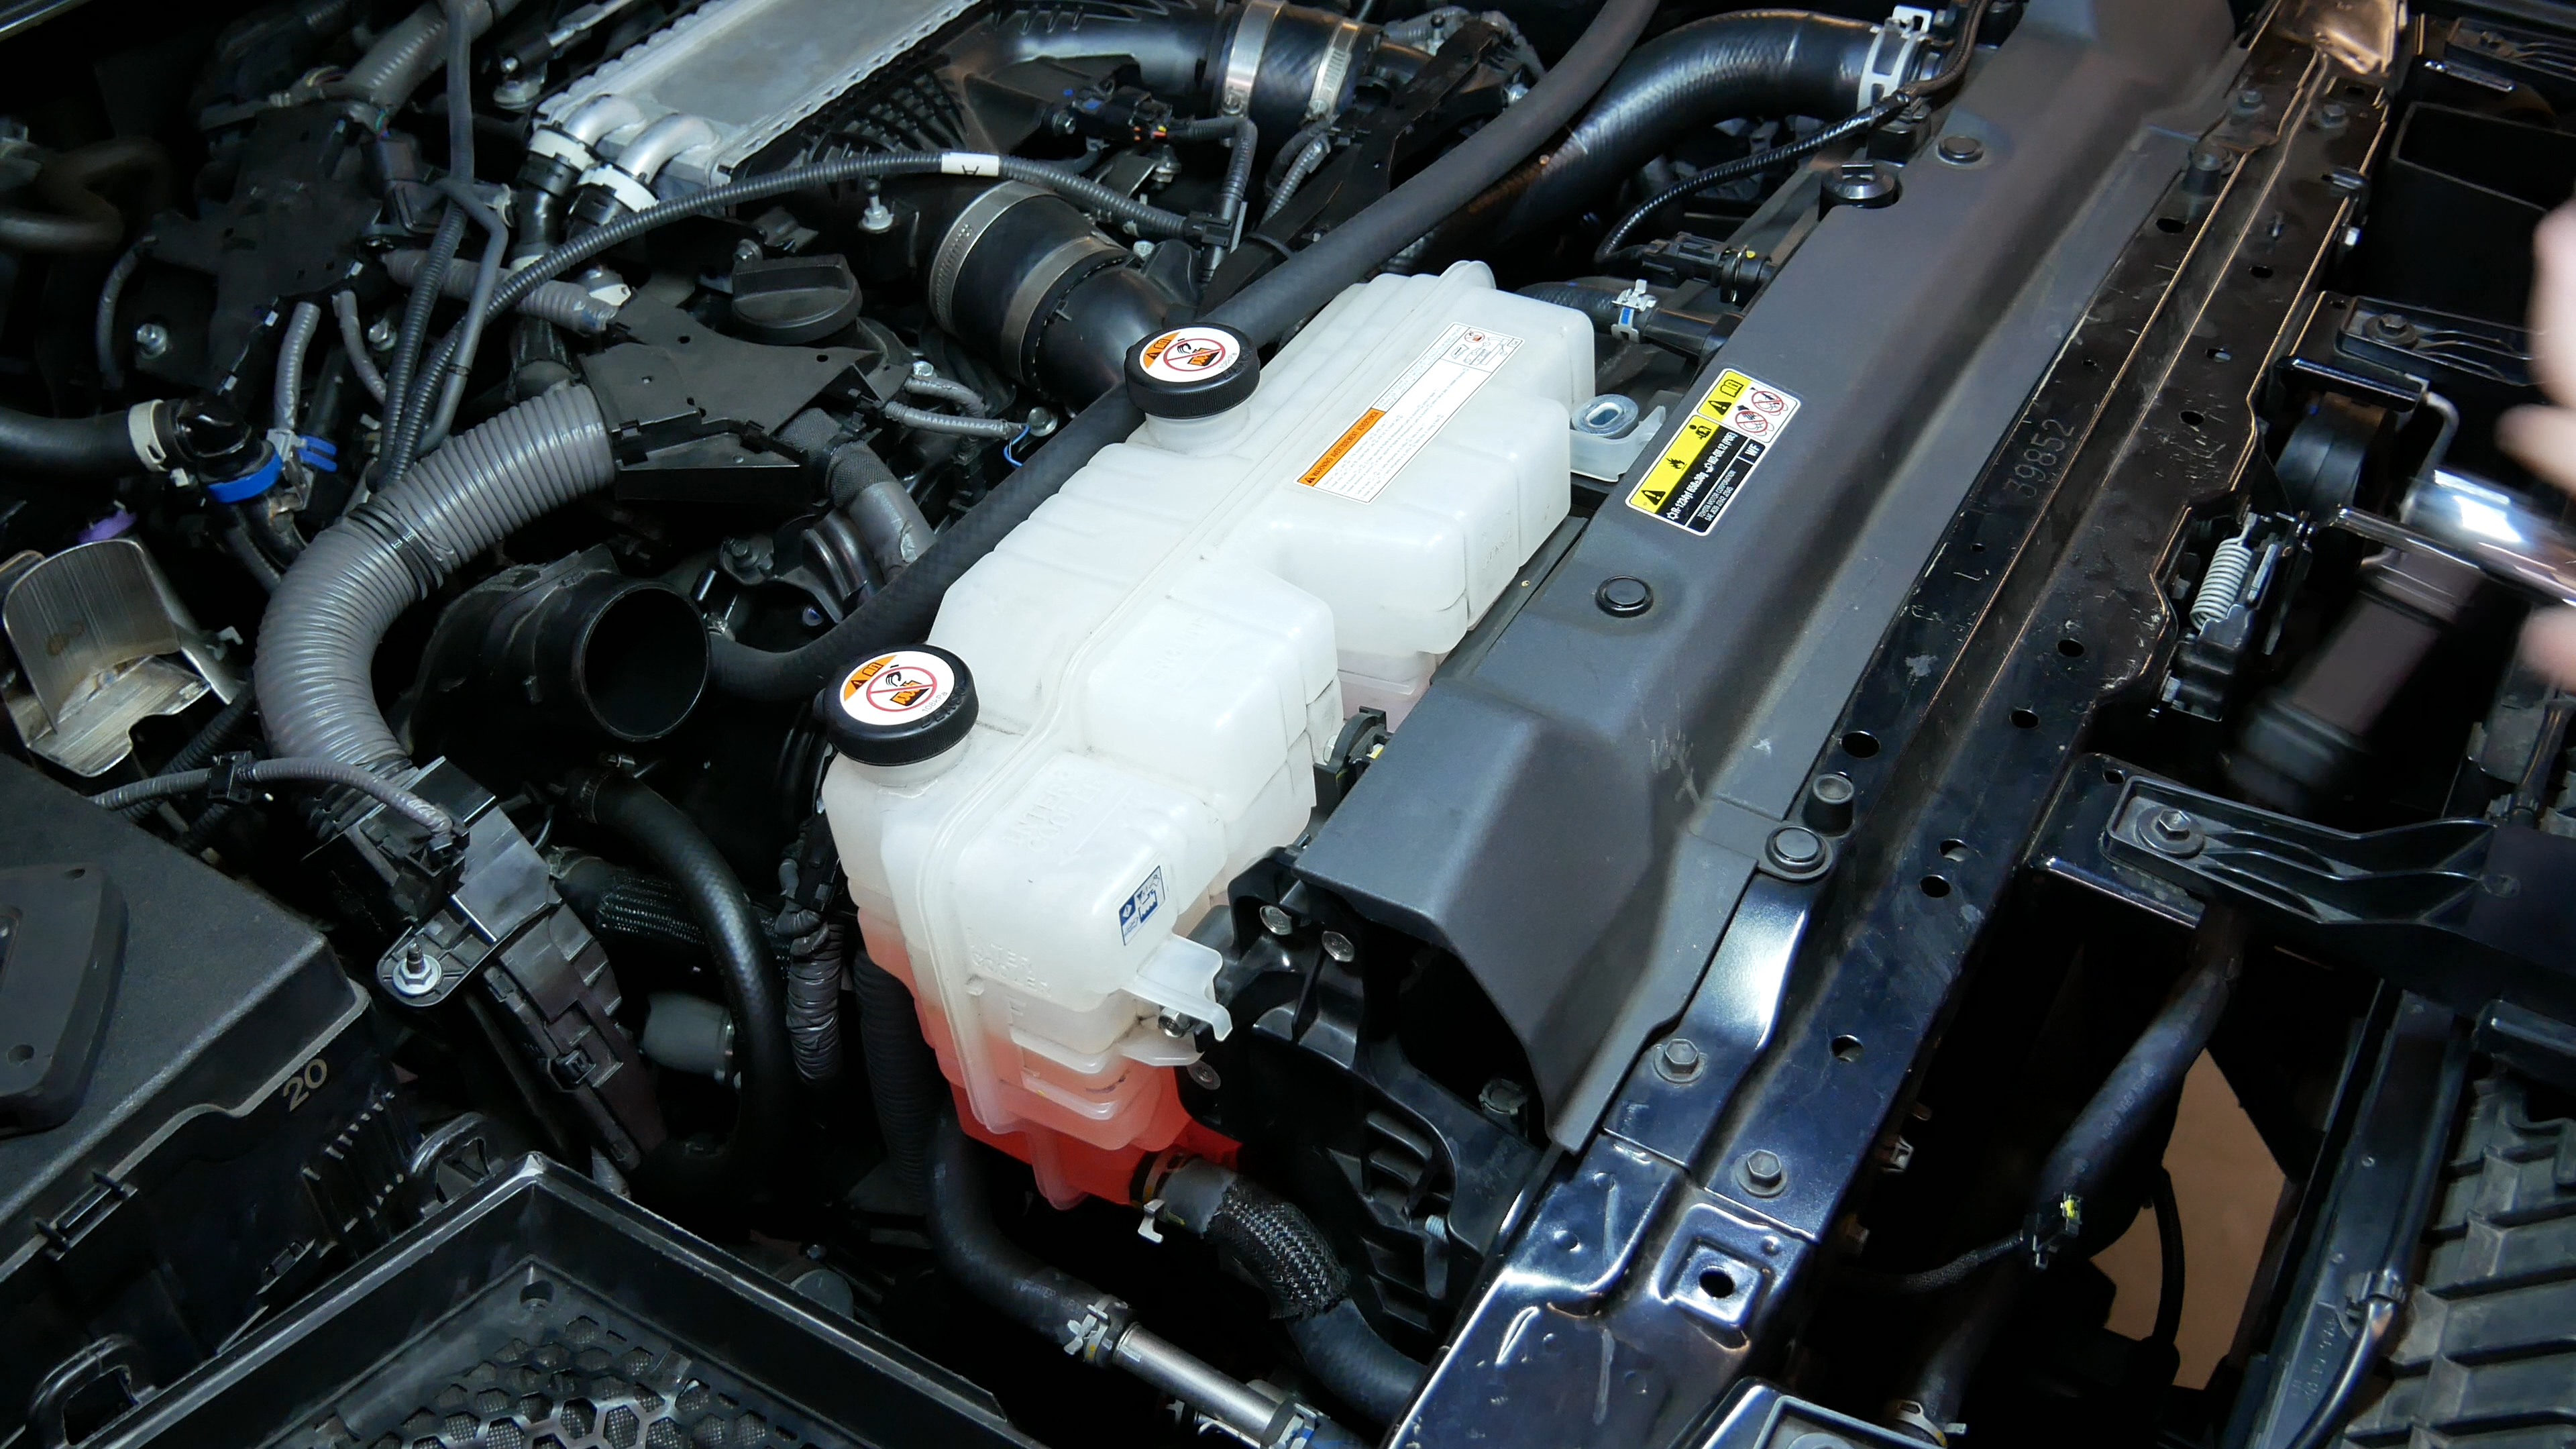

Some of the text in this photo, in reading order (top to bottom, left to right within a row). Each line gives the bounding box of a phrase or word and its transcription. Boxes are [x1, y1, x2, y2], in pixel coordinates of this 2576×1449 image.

[1311, 457, 1333, 476] WARNING
[1745, 443, 1760, 456] WF
[2002, 419, 2074, 498] 39852
[1697, 470, 1736, 517] TOYOTA MOTOR CORPORATION
[920, 686, 966, 729] DENSO
[922, 692, 948, 712] 108kPa
[282, 1058, 328, 1113] 20
